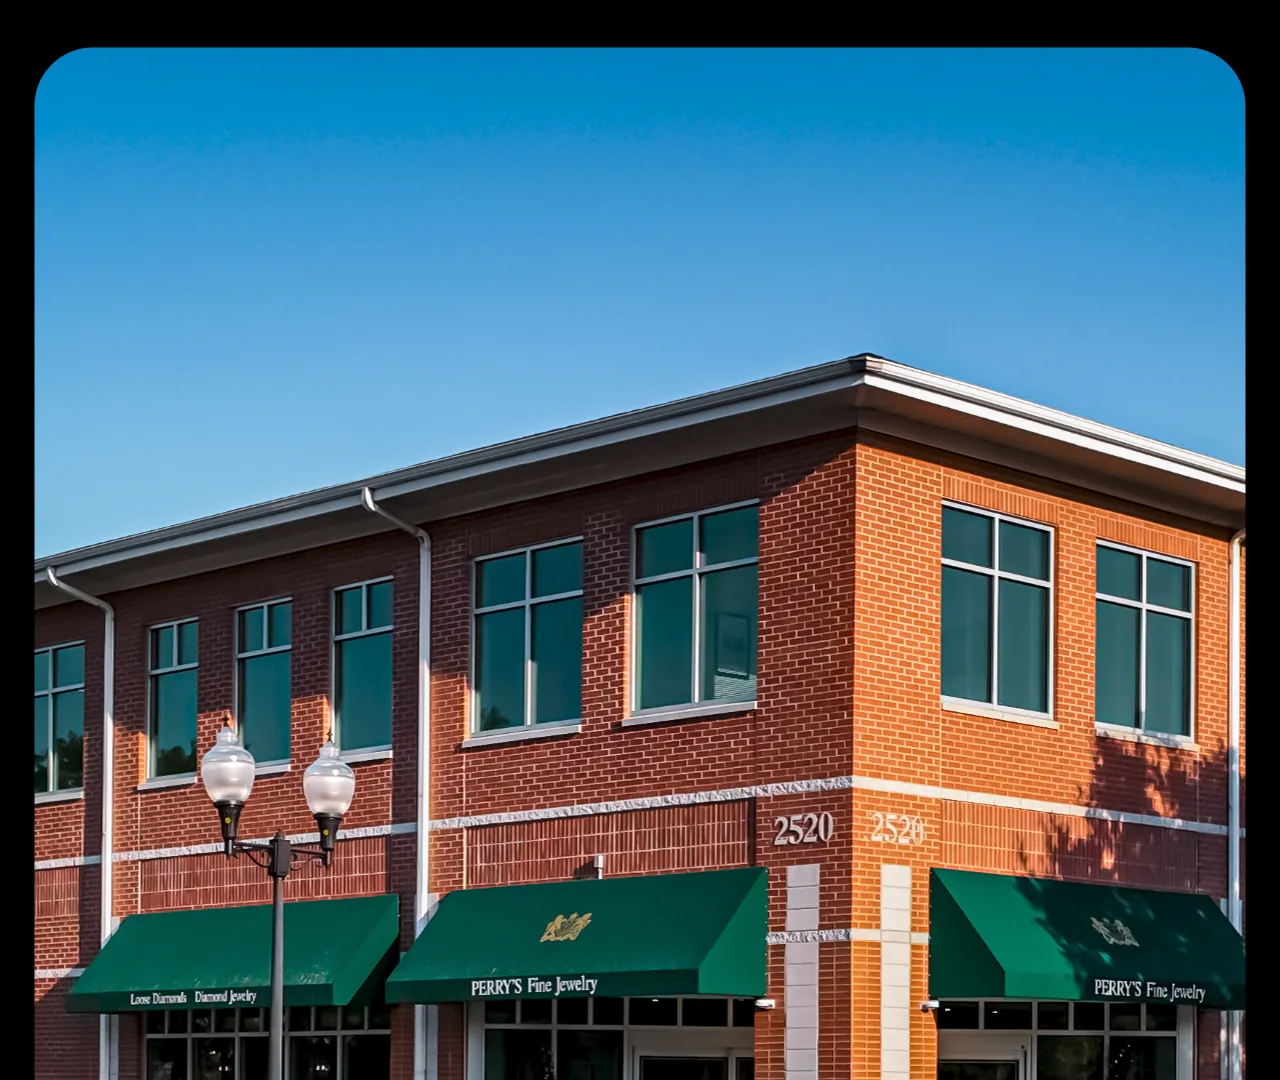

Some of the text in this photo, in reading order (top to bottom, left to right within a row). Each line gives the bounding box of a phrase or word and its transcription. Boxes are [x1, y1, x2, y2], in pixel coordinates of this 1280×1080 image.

[774, 811, 834, 846] 2520
[871, 812, 924, 846] 2520
[130, 989, 257, 1006] Loose Diamonds Diamond Jewelry
[471, 974, 598, 996] PERRY'S Fine Jewelry
[1094, 979, 1206, 1004] PERRY'S Fine Jewelry
